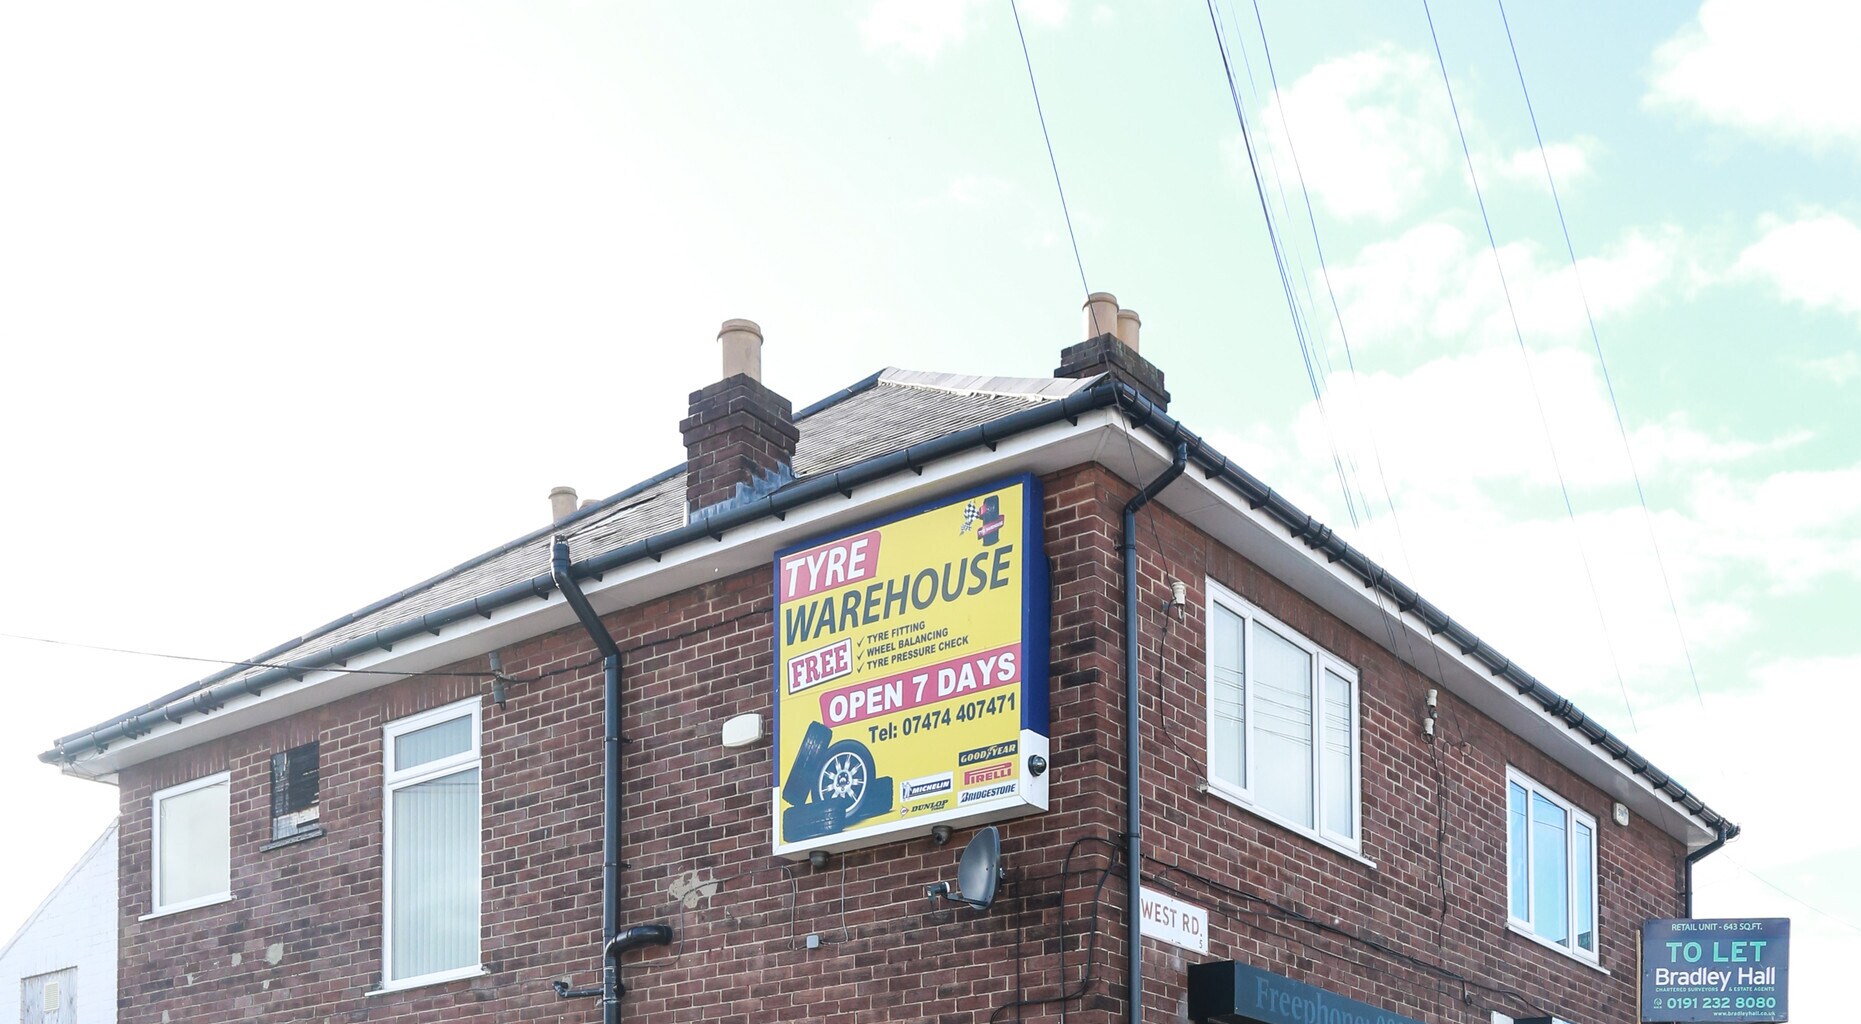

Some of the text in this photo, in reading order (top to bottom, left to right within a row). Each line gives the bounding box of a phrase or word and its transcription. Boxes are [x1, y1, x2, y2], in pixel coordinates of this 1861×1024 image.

[785, 538, 868, 597] TYRE
[785, 544, 1013, 646] WAREHOUSE
[867, 621, 925, 644] TYRE FITTING
[867, 628, 948, 657] WHEEL BALANCING
[792, 642, 848, 688] FREE
[867, 635, 969, 670] TYRE PRESSURE CHECK
[829, 652, 1016, 723] OPEN 7 DAYS
[868, 692, 1015, 743] Tel: 07474 407471
[964, 762, 1012, 785] PIRELLI
[911, 781, 950, 794] MICHELIN
[960, 783, 1016, 803] BRIDGESTONE
[911, 799, 949, 812] DUNLOP
[1140, 898, 1177, 928] WEST
[1671, 923, 1697, 931] RETAIL
[1698, 923, 1718, 931] UNIT
[1666, 941, 1767, 963] TO LET
[1655, 966, 1776, 992] Bradley Hall
[1666, 997, 1777, 1009] 0191 232 8080
